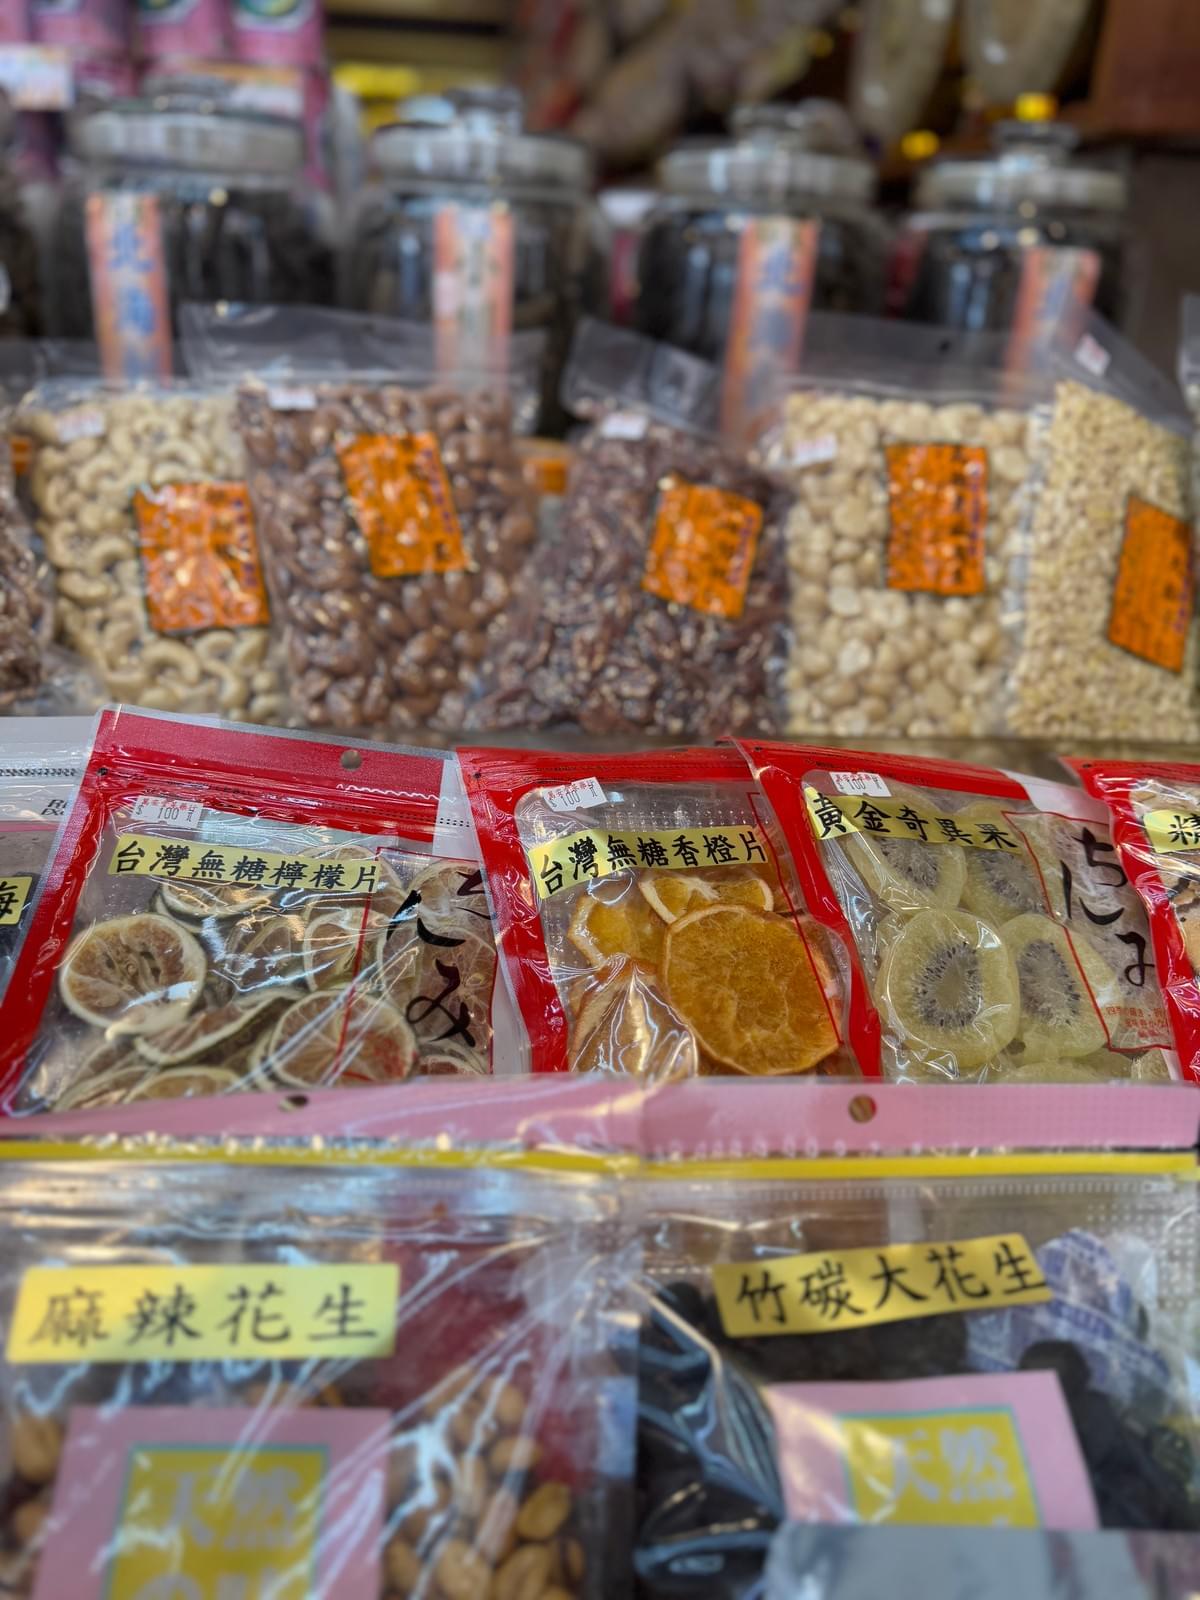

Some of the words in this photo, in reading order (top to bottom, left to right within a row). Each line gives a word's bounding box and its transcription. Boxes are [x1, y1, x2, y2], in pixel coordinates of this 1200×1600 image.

[157, 806, 180, 821] 100
[813, 792, 1018, 849] 黃金奇異果
[116, 840, 378, 893] 台灣無糖檸檬片
[540, 830, 766, 894] 台灣無糖香橙片
[735, 1241, 1048, 1327] 竹碳大花生
[28, 1283, 379, 1349] 麻辣花生
